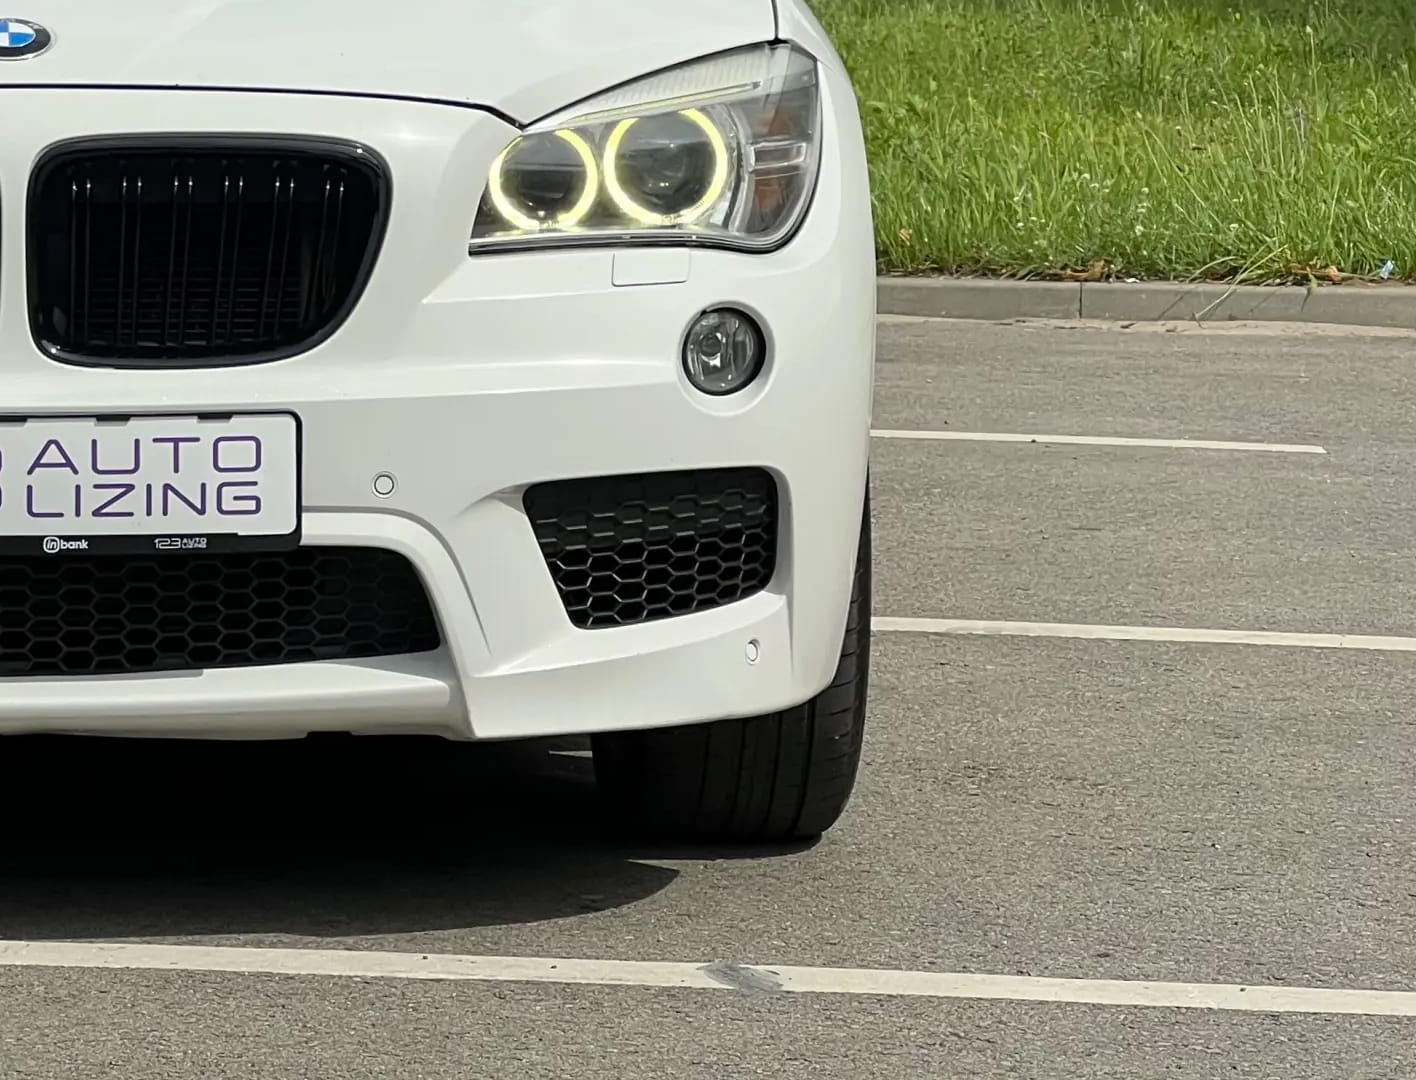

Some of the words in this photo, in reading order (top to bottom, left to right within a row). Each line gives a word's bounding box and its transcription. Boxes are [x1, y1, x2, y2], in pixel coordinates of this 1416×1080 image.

[27, 435, 262, 476] AUTO
[27, 480, 262, 519] LIZING
[155, 538, 181, 549] 123
